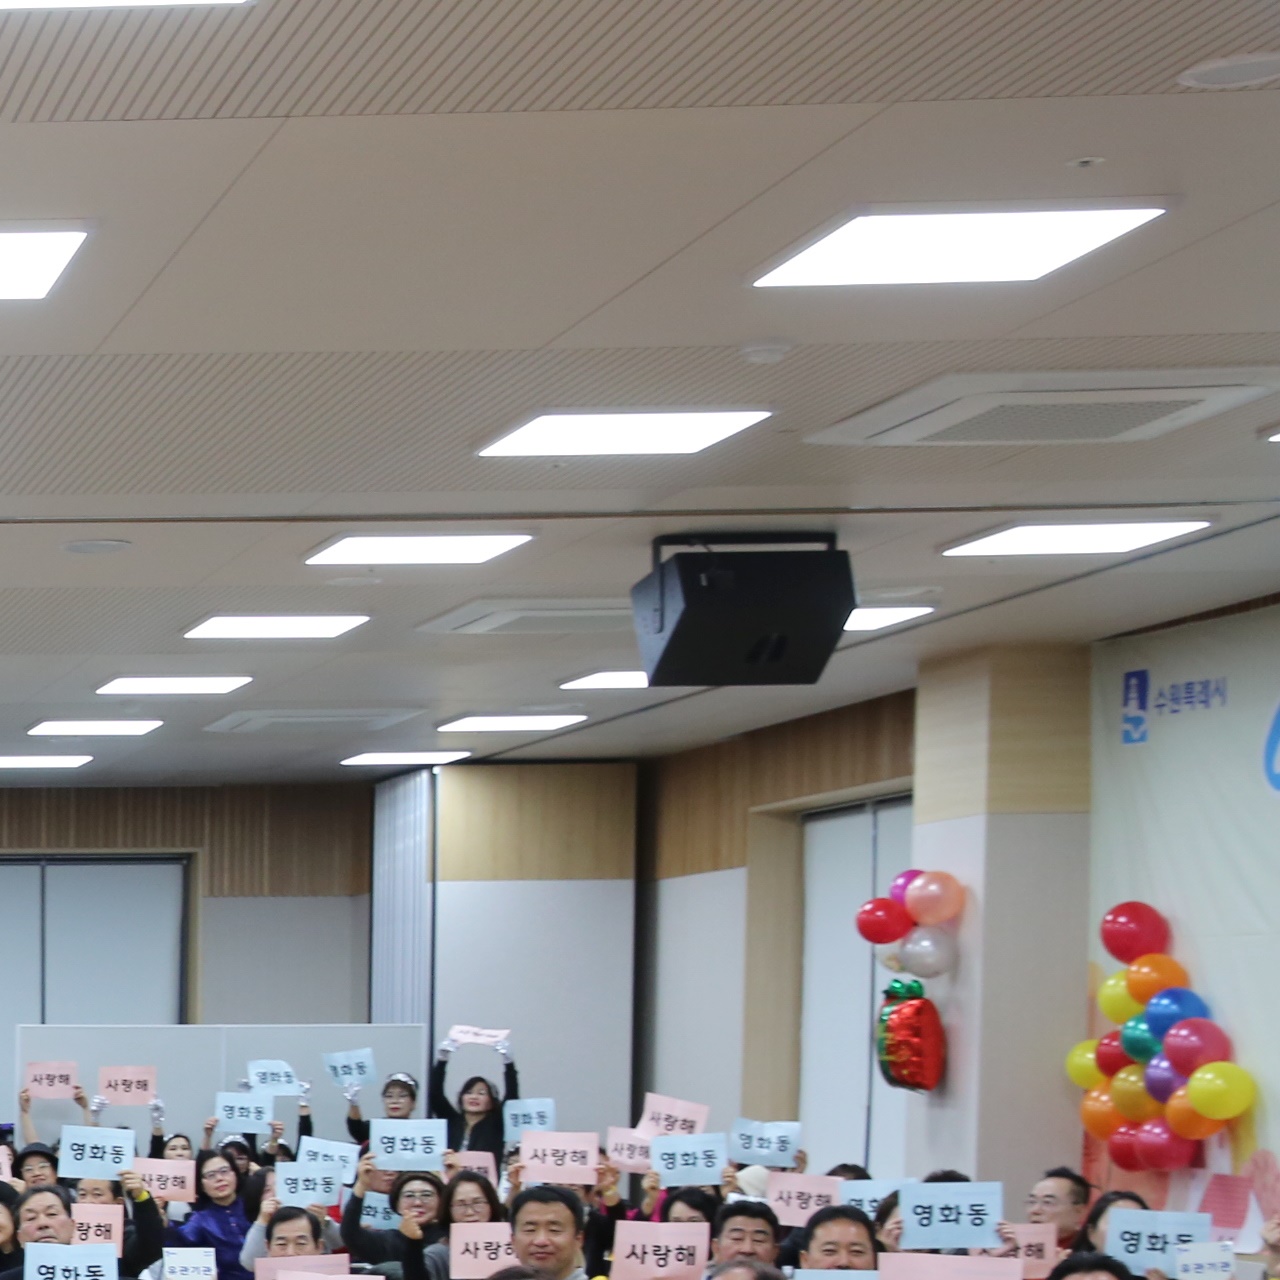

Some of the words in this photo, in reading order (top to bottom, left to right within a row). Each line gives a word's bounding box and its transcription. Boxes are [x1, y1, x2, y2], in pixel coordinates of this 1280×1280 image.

[1154, 679, 1228, 714] 수원특례시
[32, 1074, 70, 1086] 사랑해
[257, 1069, 294, 1084] 영화동
[106, 1079, 148, 1092] 사랑해
[223, 1105, 264, 1120] 영화동
[510, 1111, 547, 1127] 영화동
[650, 1113, 696, 1134] 사랑해
[380, 1136, 436, 1154] 영화동
[739, 1133, 791, 1152] 영화동
[71, 1143, 124, 1164] 영화동
[530, 1149, 587, 1166] 사랑해
[661, 1150, 717, 1170] 영화동
[285, 1177, 335, 1194] 영화동
[779, 1192, 834, 1211] 사랑해
[363, 1203, 397, 1220] 화동
[913, 1204, 988, 1227] 영화동
[76, 1223, 111, 1241] 랑해
[626, 1245, 695, 1267] 사랑해
[168, 1265, 213, 1276] 유관기관
[1180, 1262, 1231, 1274] 유관기관
